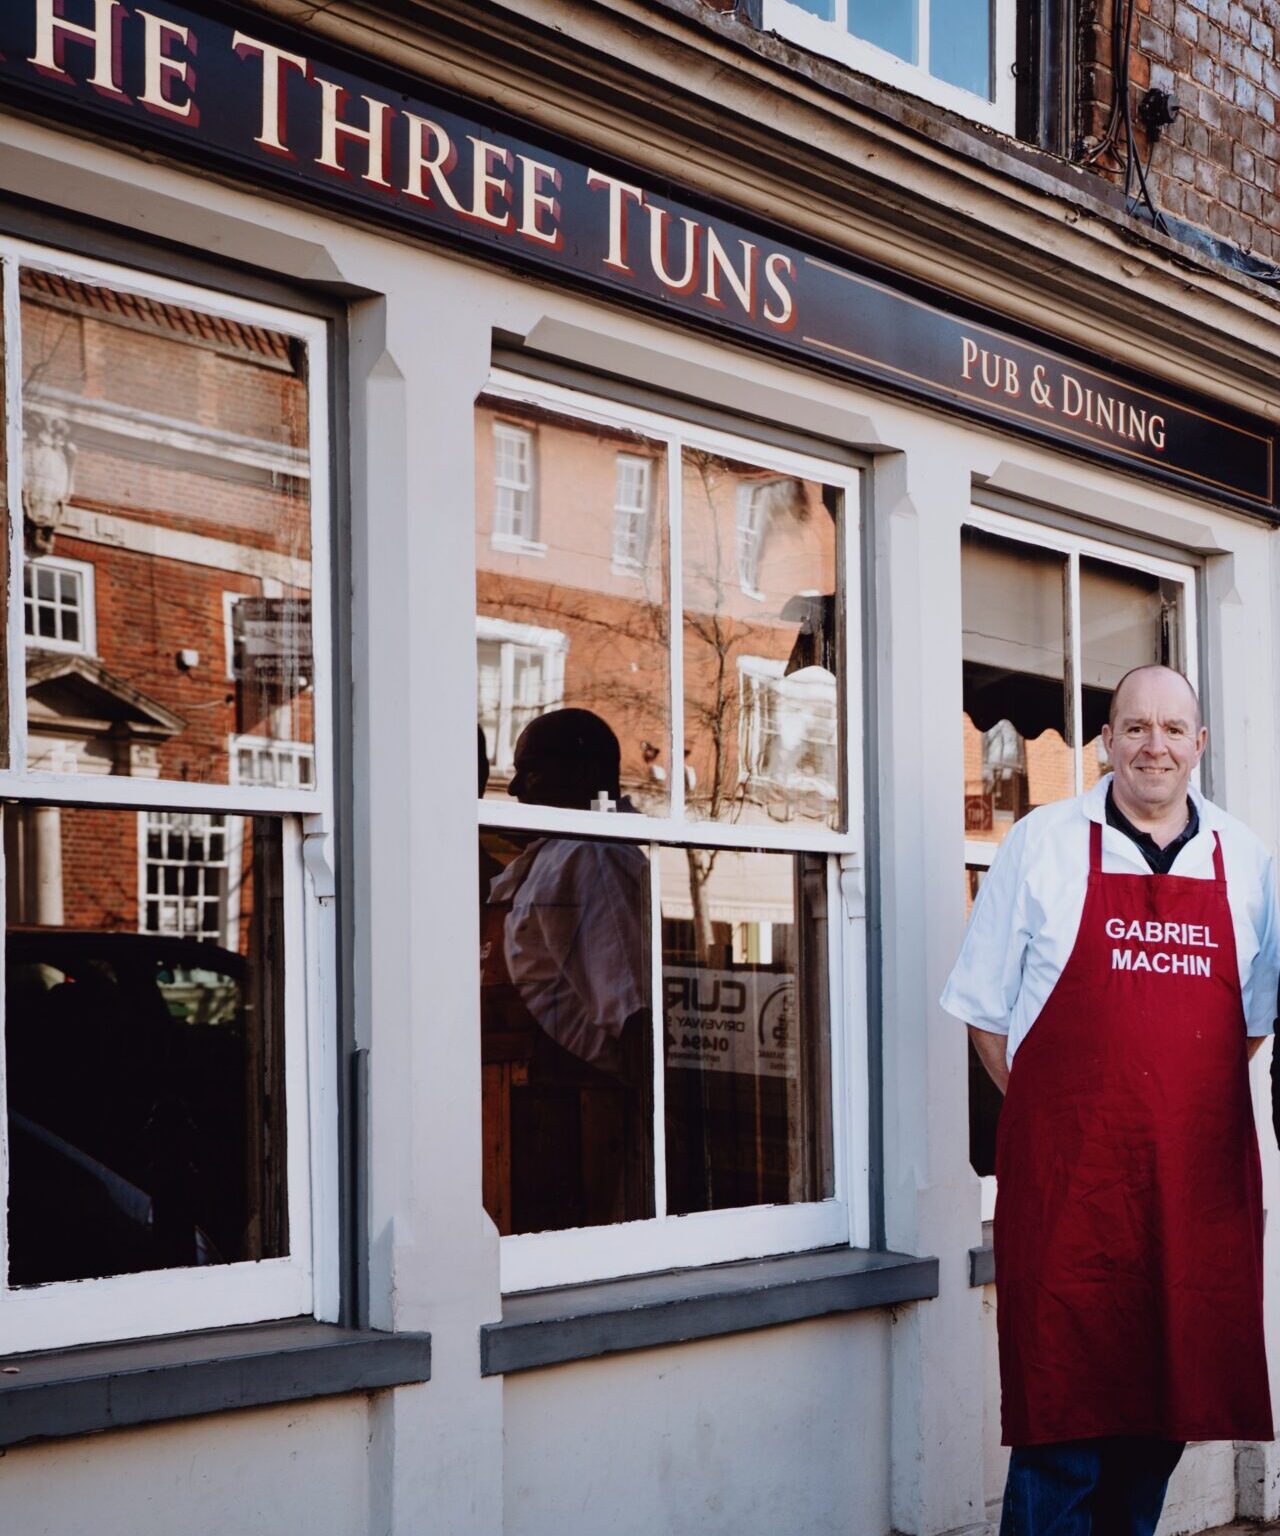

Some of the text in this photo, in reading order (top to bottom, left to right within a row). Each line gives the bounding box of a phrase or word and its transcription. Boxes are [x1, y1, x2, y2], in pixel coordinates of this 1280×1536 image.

[27, 0, 798, 328] HE THREE TUNS
[960, 337, 1167, 451] PUB & DINING
[1105, 918, 1219, 948] GABRIEL
[1111, 949, 1211, 978] MACHIN
